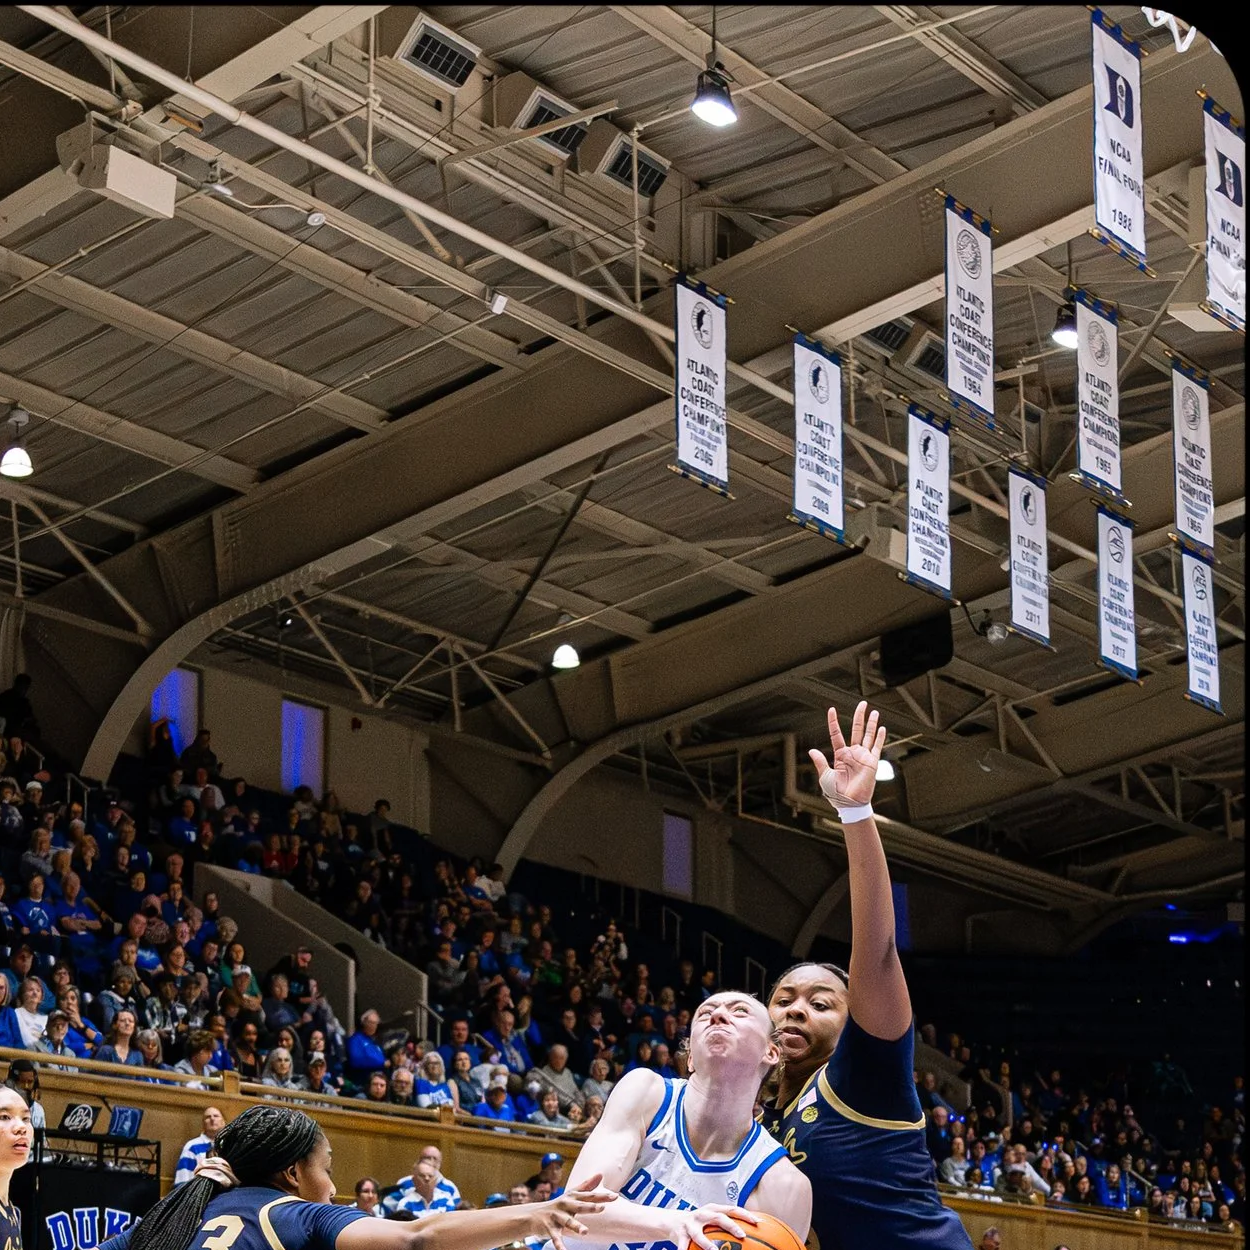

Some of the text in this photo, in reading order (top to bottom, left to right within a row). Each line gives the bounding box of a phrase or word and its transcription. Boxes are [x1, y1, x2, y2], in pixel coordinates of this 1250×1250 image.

[1110, 138, 1132, 165] NCAA
[1098, 157, 1122, 185] FINAL
[1220, 218, 1240, 242] NCAA
[956, 284, 985, 313] ATLANTIC
[959, 304, 982, 327] COAST
[950, 314, 993, 351] CONFERENCE
[952, 332, 990, 366] CHAMPIONS
[686, 358, 719, 385] ATLANTIC
[691, 376, 715, 399] COAST
[680, 387, 726, 421] CONFERENCE
[915, 478, 943, 504] ATLANTIC
